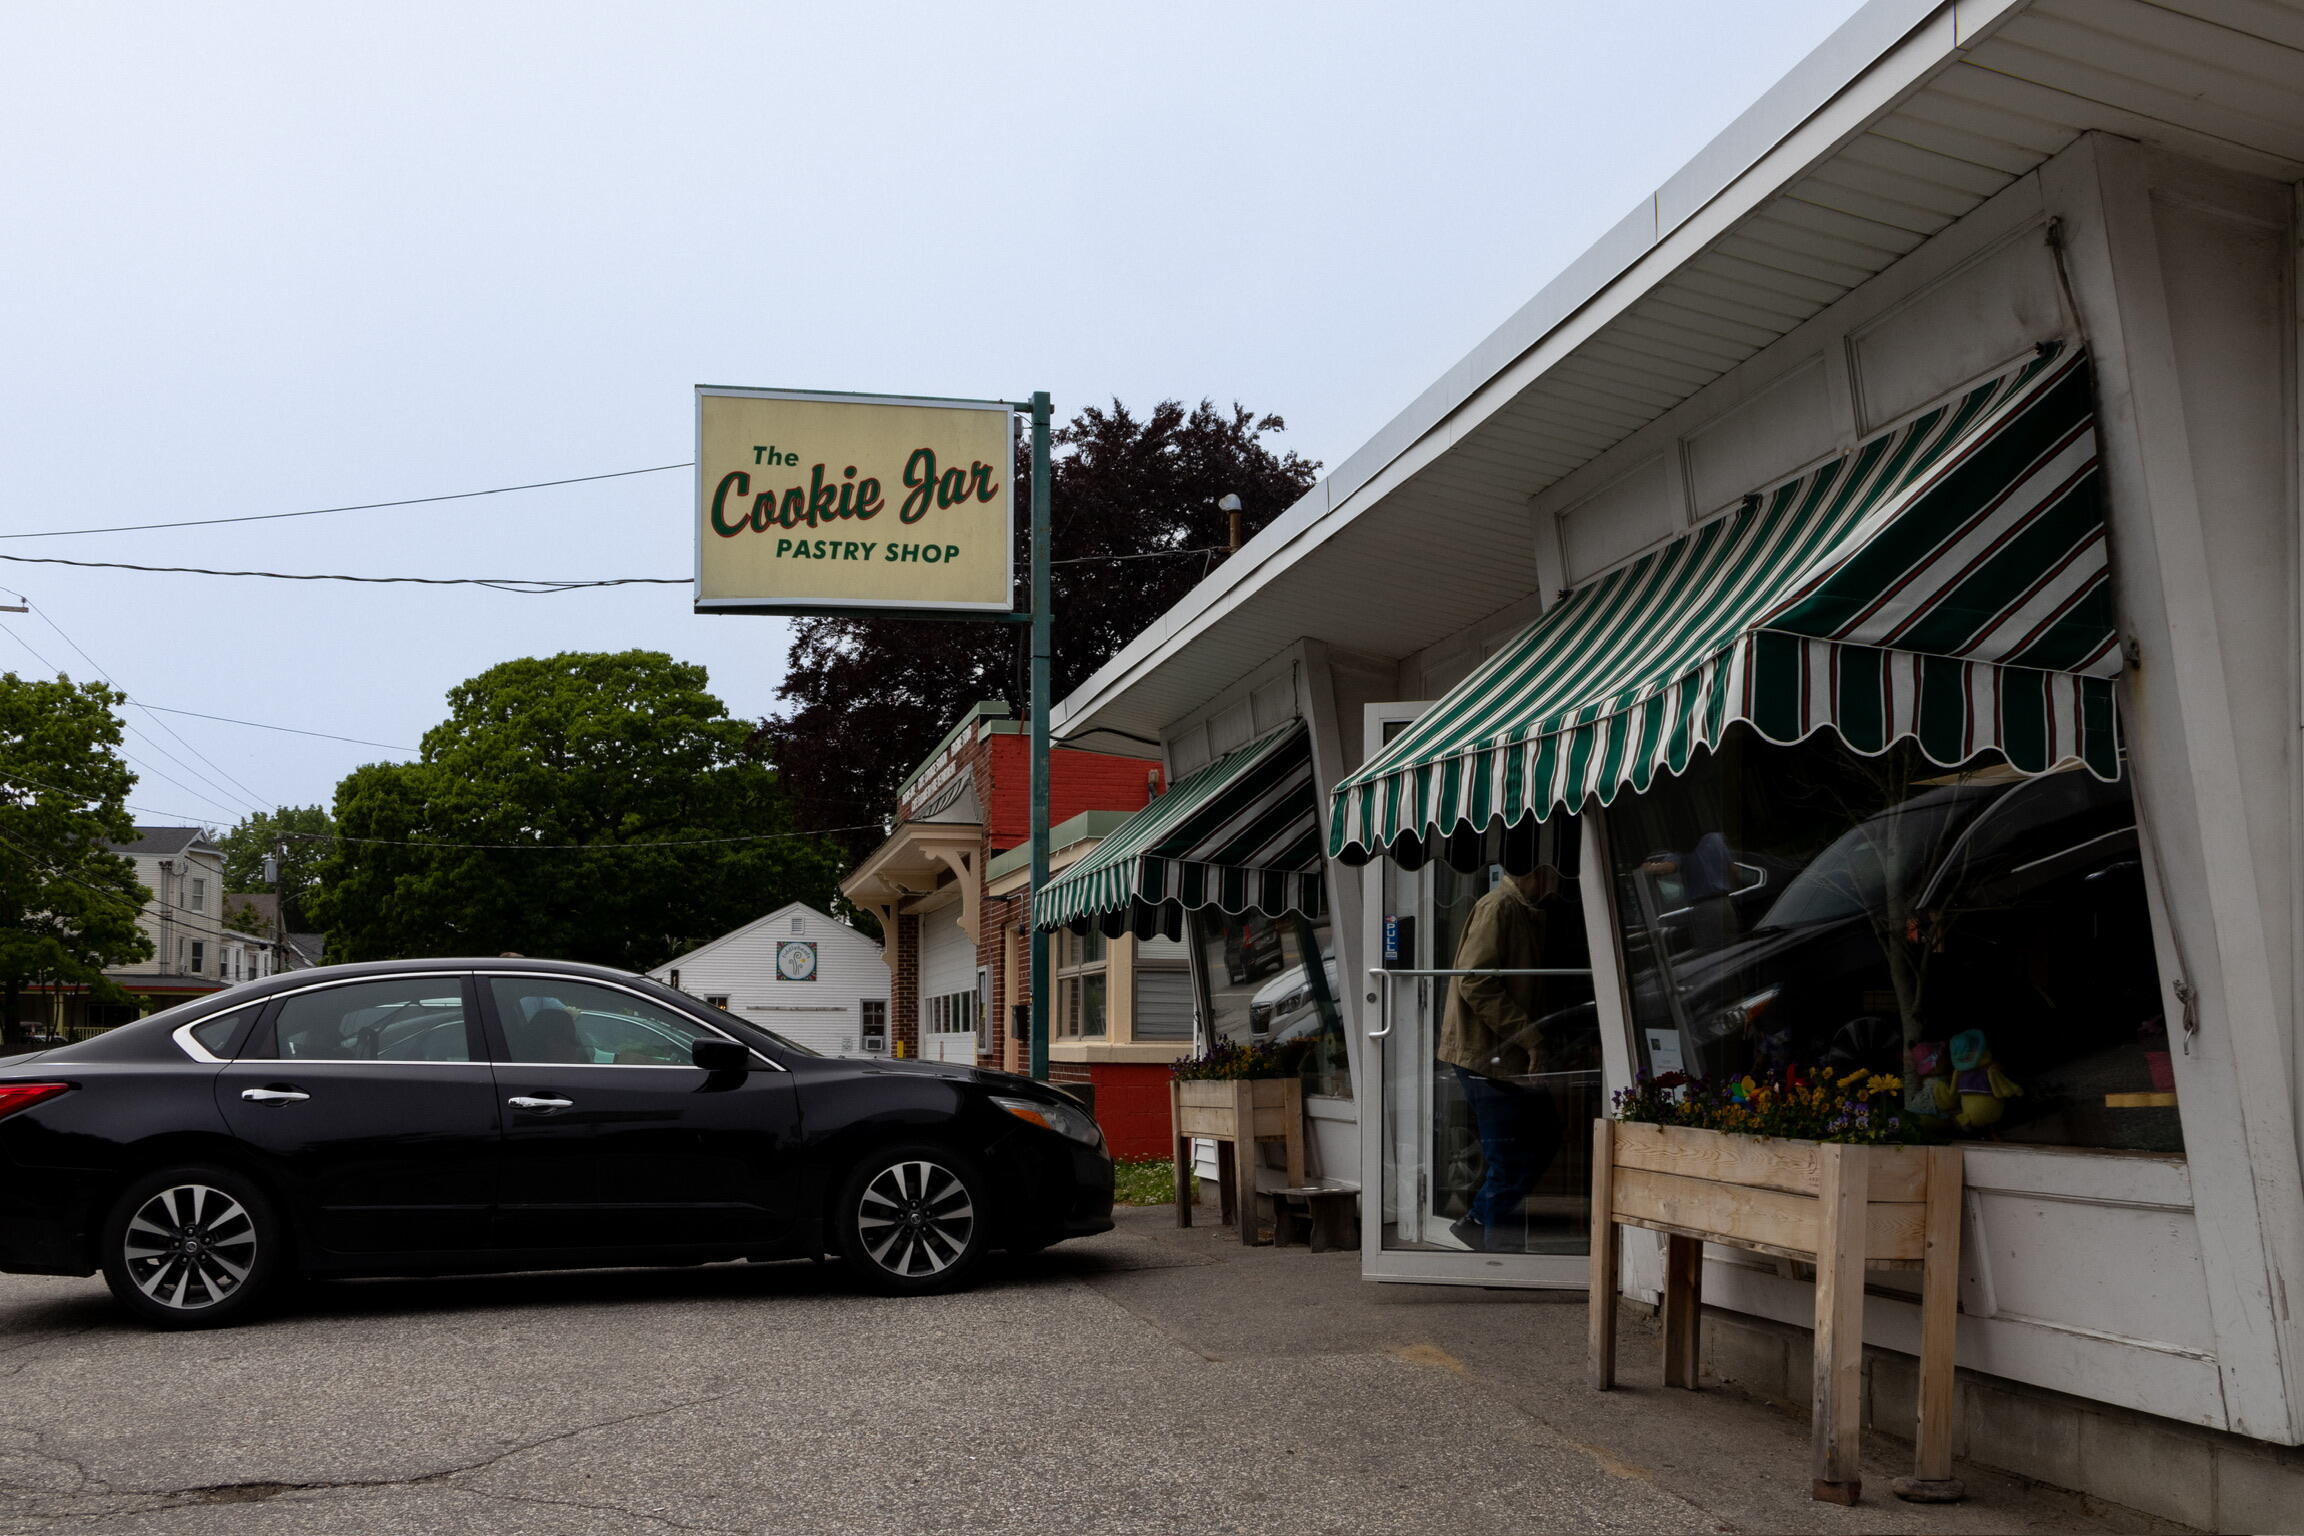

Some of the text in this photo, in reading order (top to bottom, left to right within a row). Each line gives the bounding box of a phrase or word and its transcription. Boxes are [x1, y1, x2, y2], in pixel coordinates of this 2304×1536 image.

[753, 445, 799, 466] The
[711, 447, 999, 538] Cookie Jar
[776, 539, 960, 563] PASTRY SHOP
[1386, 923, 1396, 951] PULL
